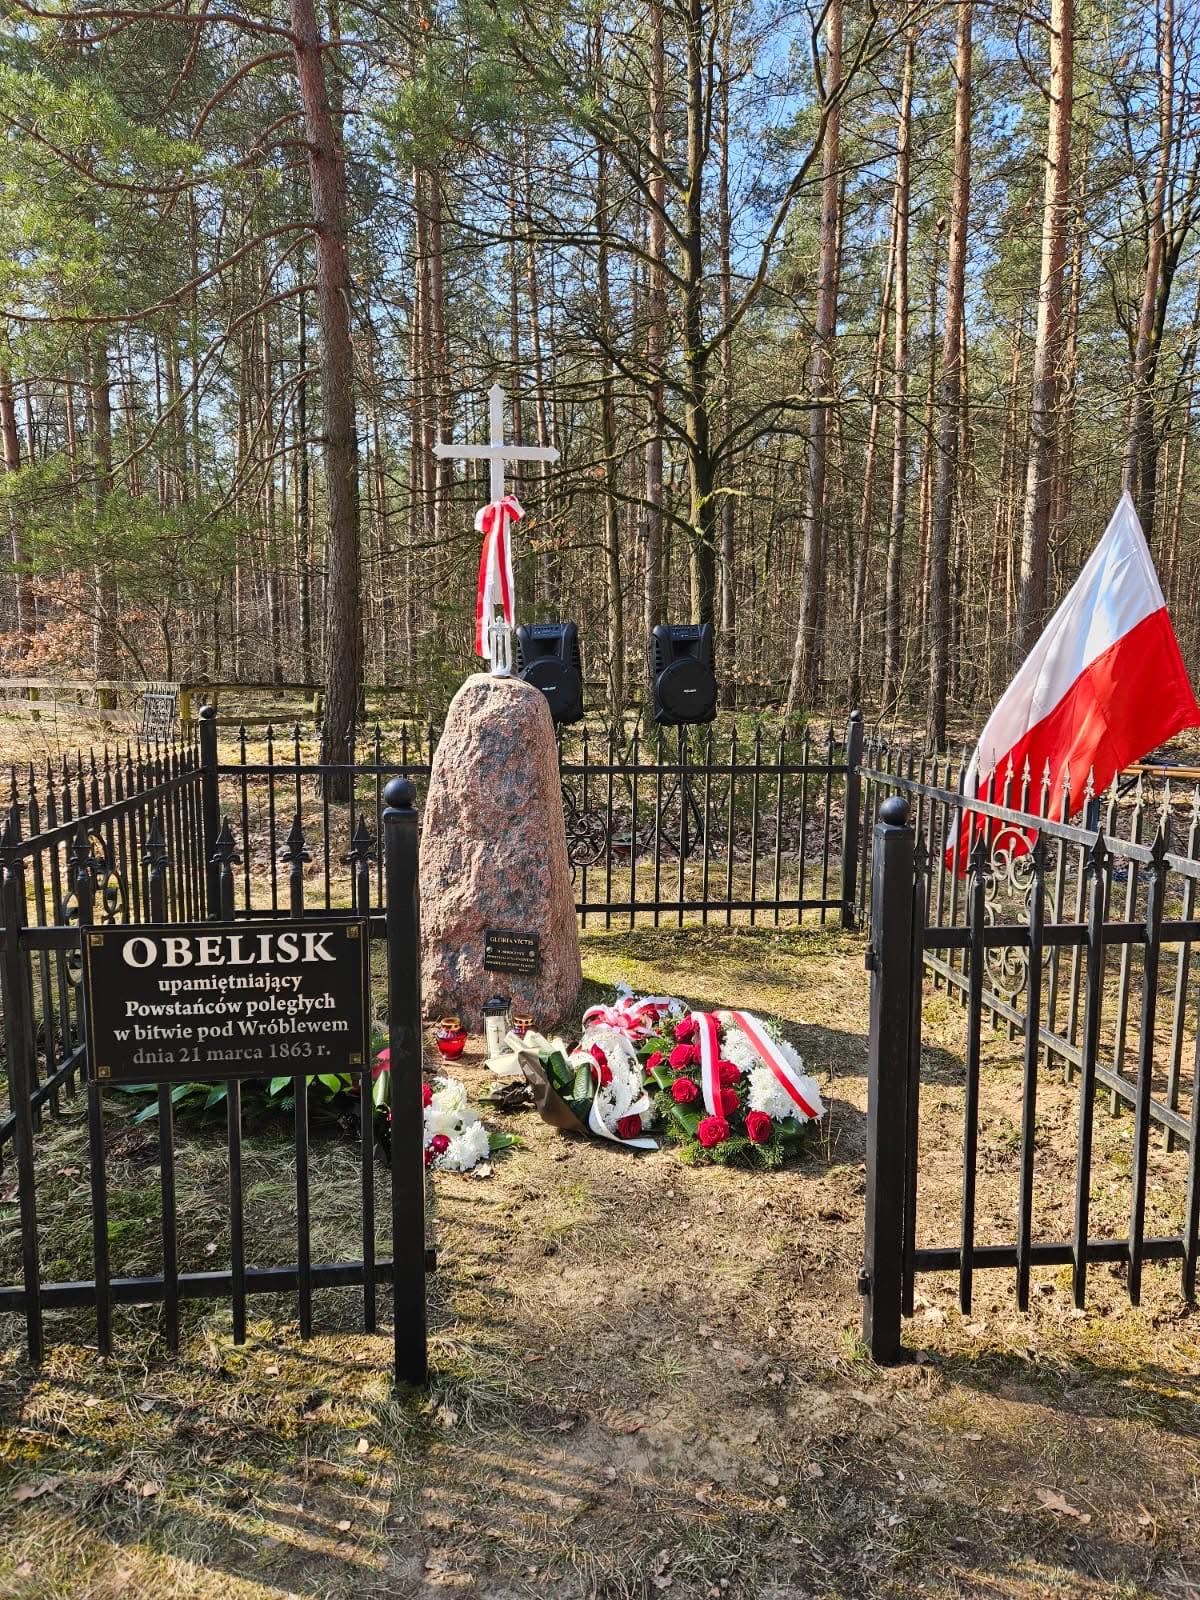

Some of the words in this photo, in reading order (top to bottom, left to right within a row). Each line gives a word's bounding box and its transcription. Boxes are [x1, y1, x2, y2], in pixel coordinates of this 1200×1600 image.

[122, 931, 337, 968] OBELISK
[158, 973, 303, 995] upamiętniający
[125, 998, 242, 1017] Powstańców
[246, 993, 336, 1017] poległych
[113, 1029, 130, 1041] w
[133, 1024, 193, 1041] bitwie
[197, 1021, 234, 1043] pod
[237, 1017, 349, 1037] Wróblewem
[133, 1047, 174, 1064] dnia
[180, 1047, 201, 1062] 21
[207, 1045, 263, 1061] marca
[269, 1041, 312, 1059] 1863
[317, 1043, 331, 1056] r.
